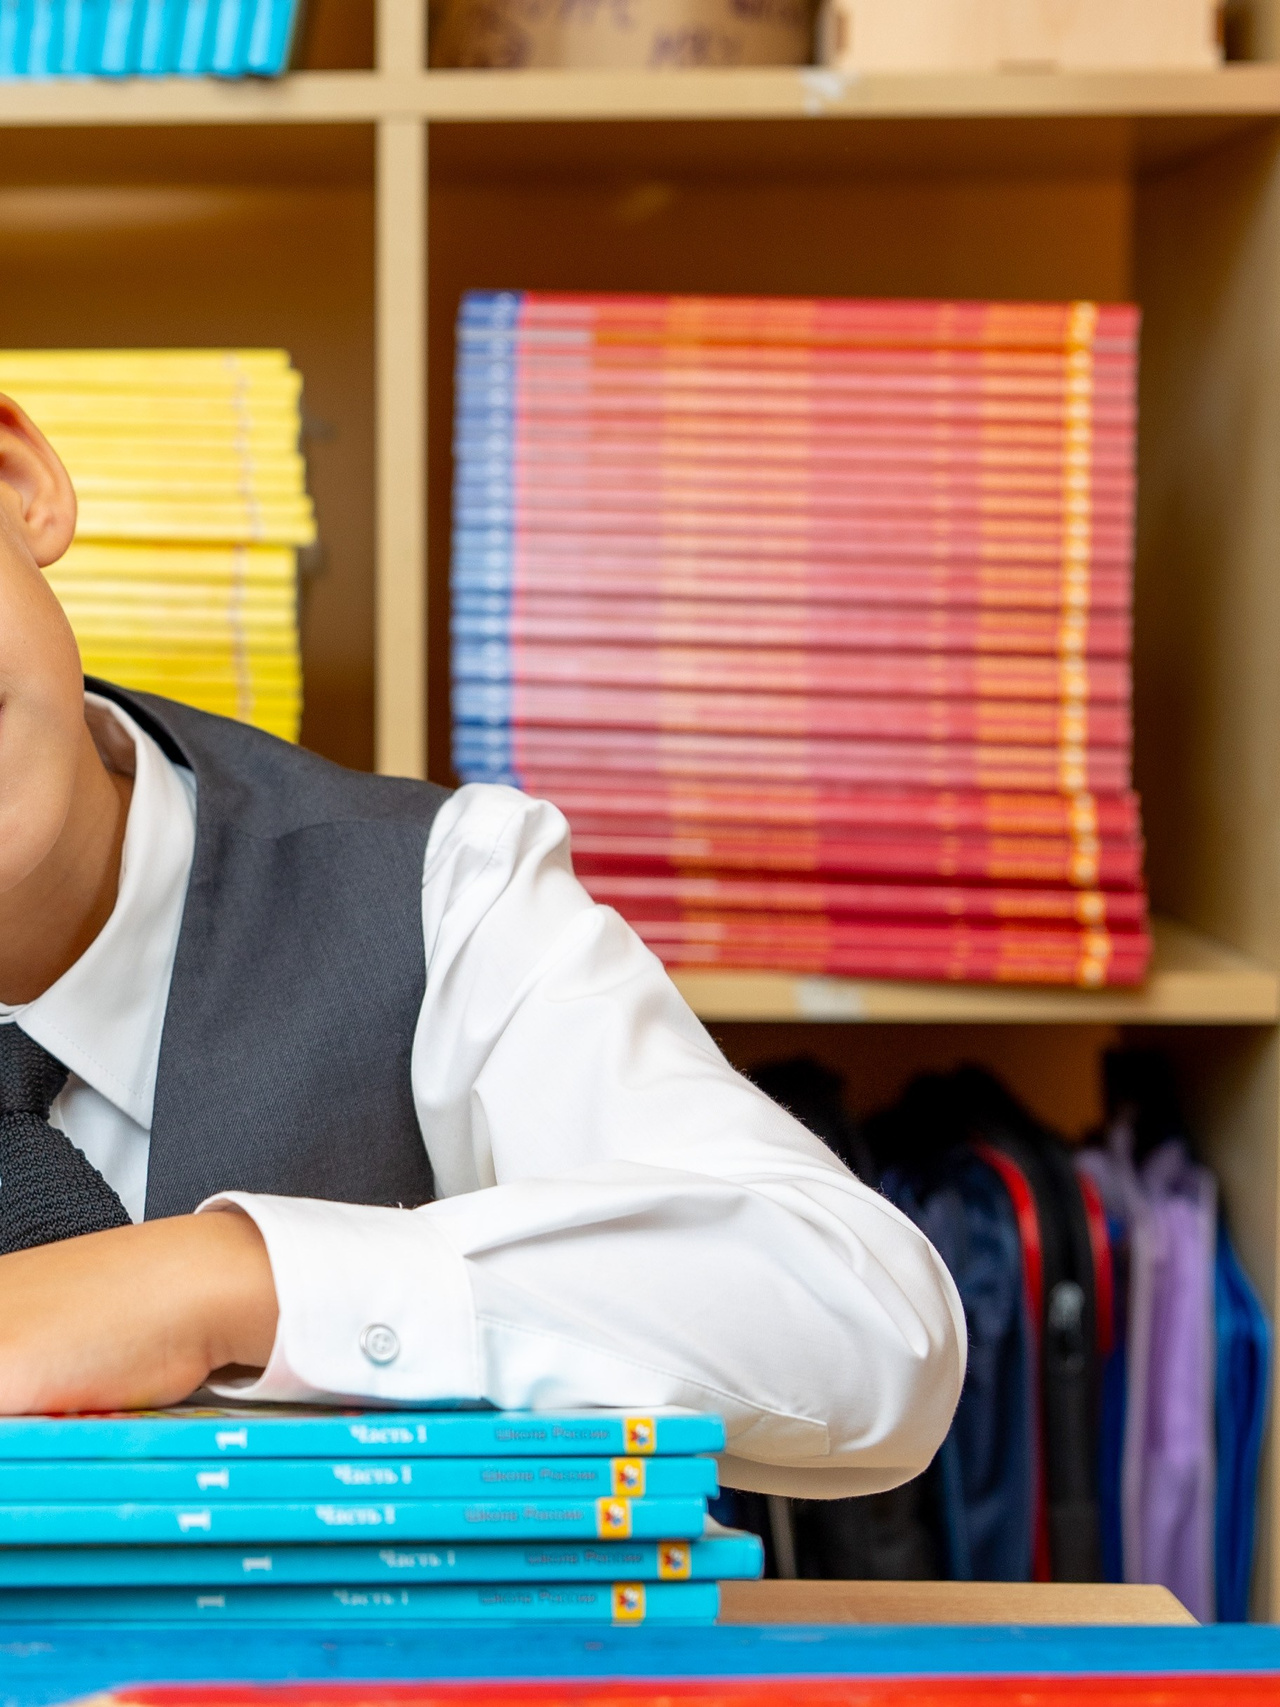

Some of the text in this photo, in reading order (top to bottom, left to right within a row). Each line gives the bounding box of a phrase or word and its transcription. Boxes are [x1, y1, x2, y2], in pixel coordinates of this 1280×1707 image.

[349, 1425, 413, 1444] Часть
[333, 1464, 398, 1485] Часть
[316, 1504, 382, 1525] Часть
[379, 1550, 441, 1568] Часть
[333, 1590, 394, 1605] Часть
